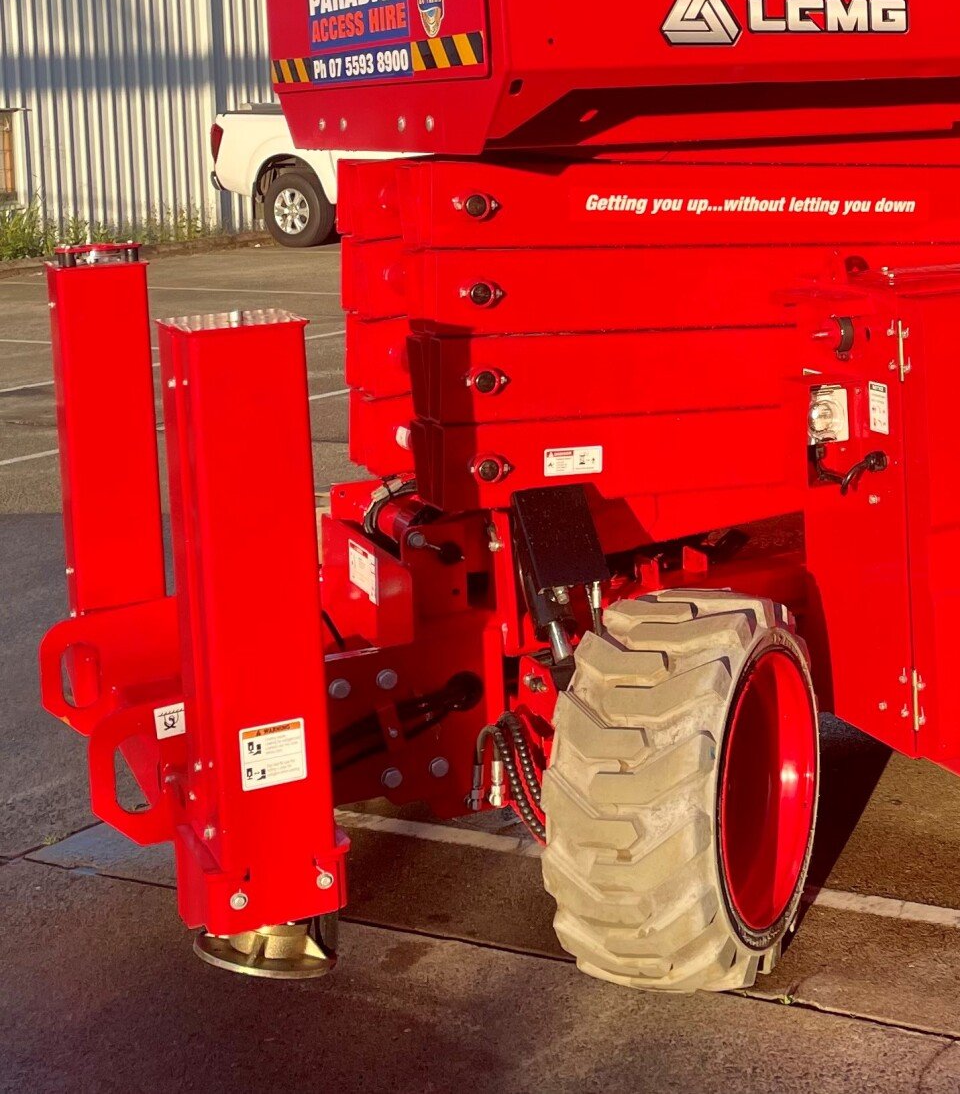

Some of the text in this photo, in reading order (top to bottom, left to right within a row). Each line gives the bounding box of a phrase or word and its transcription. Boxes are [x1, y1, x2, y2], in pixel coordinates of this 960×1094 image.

[312, 2, 407, 42] ACCESS HIRE
[313, 49, 409, 79] Ph 07 5593 8900
[585, 194, 648, 215] Getting
[650, 198, 683, 215] you
[788, 197, 841, 216] letting
[842, 199, 872, 215] you
[874, 198, 915, 213] down
